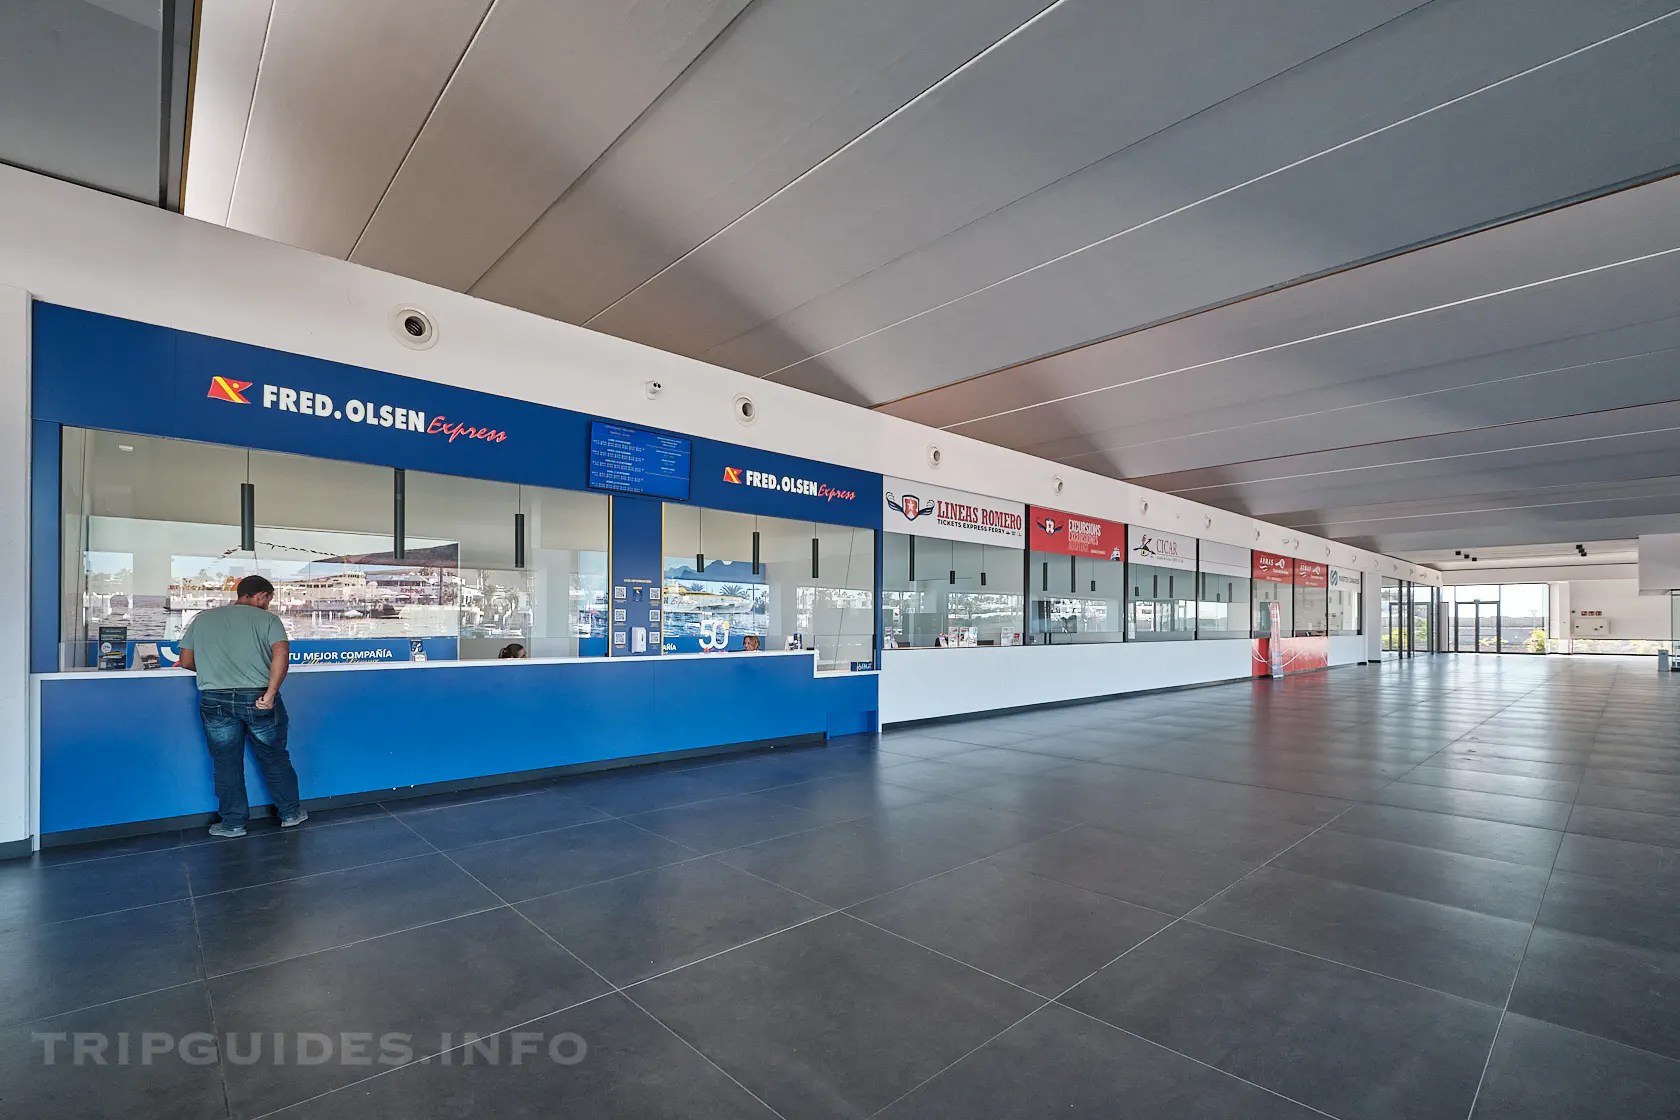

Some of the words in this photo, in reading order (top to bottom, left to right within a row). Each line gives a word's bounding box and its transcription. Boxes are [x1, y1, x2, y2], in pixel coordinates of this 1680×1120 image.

[427, 415, 507, 443] Express
[818, 483, 856, 502] Express
[937, 500, 978, 524] LINEAS
[981, 508, 1022, 530] ROMERO
[937, 518, 962, 528] TICKETS
[962, 522, 988, 532] EXPRESS
[988, 526, 1005, 535] FERRY
[1068, 519, 1102, 537] EXCURSIONS
[1156, 538, 1178, 556] CICAR
[288, 652, 301, 661] TU
[303, 651, 338, 661] MEJOR
[340, 648, 393, 660] COMPAÑÍA
